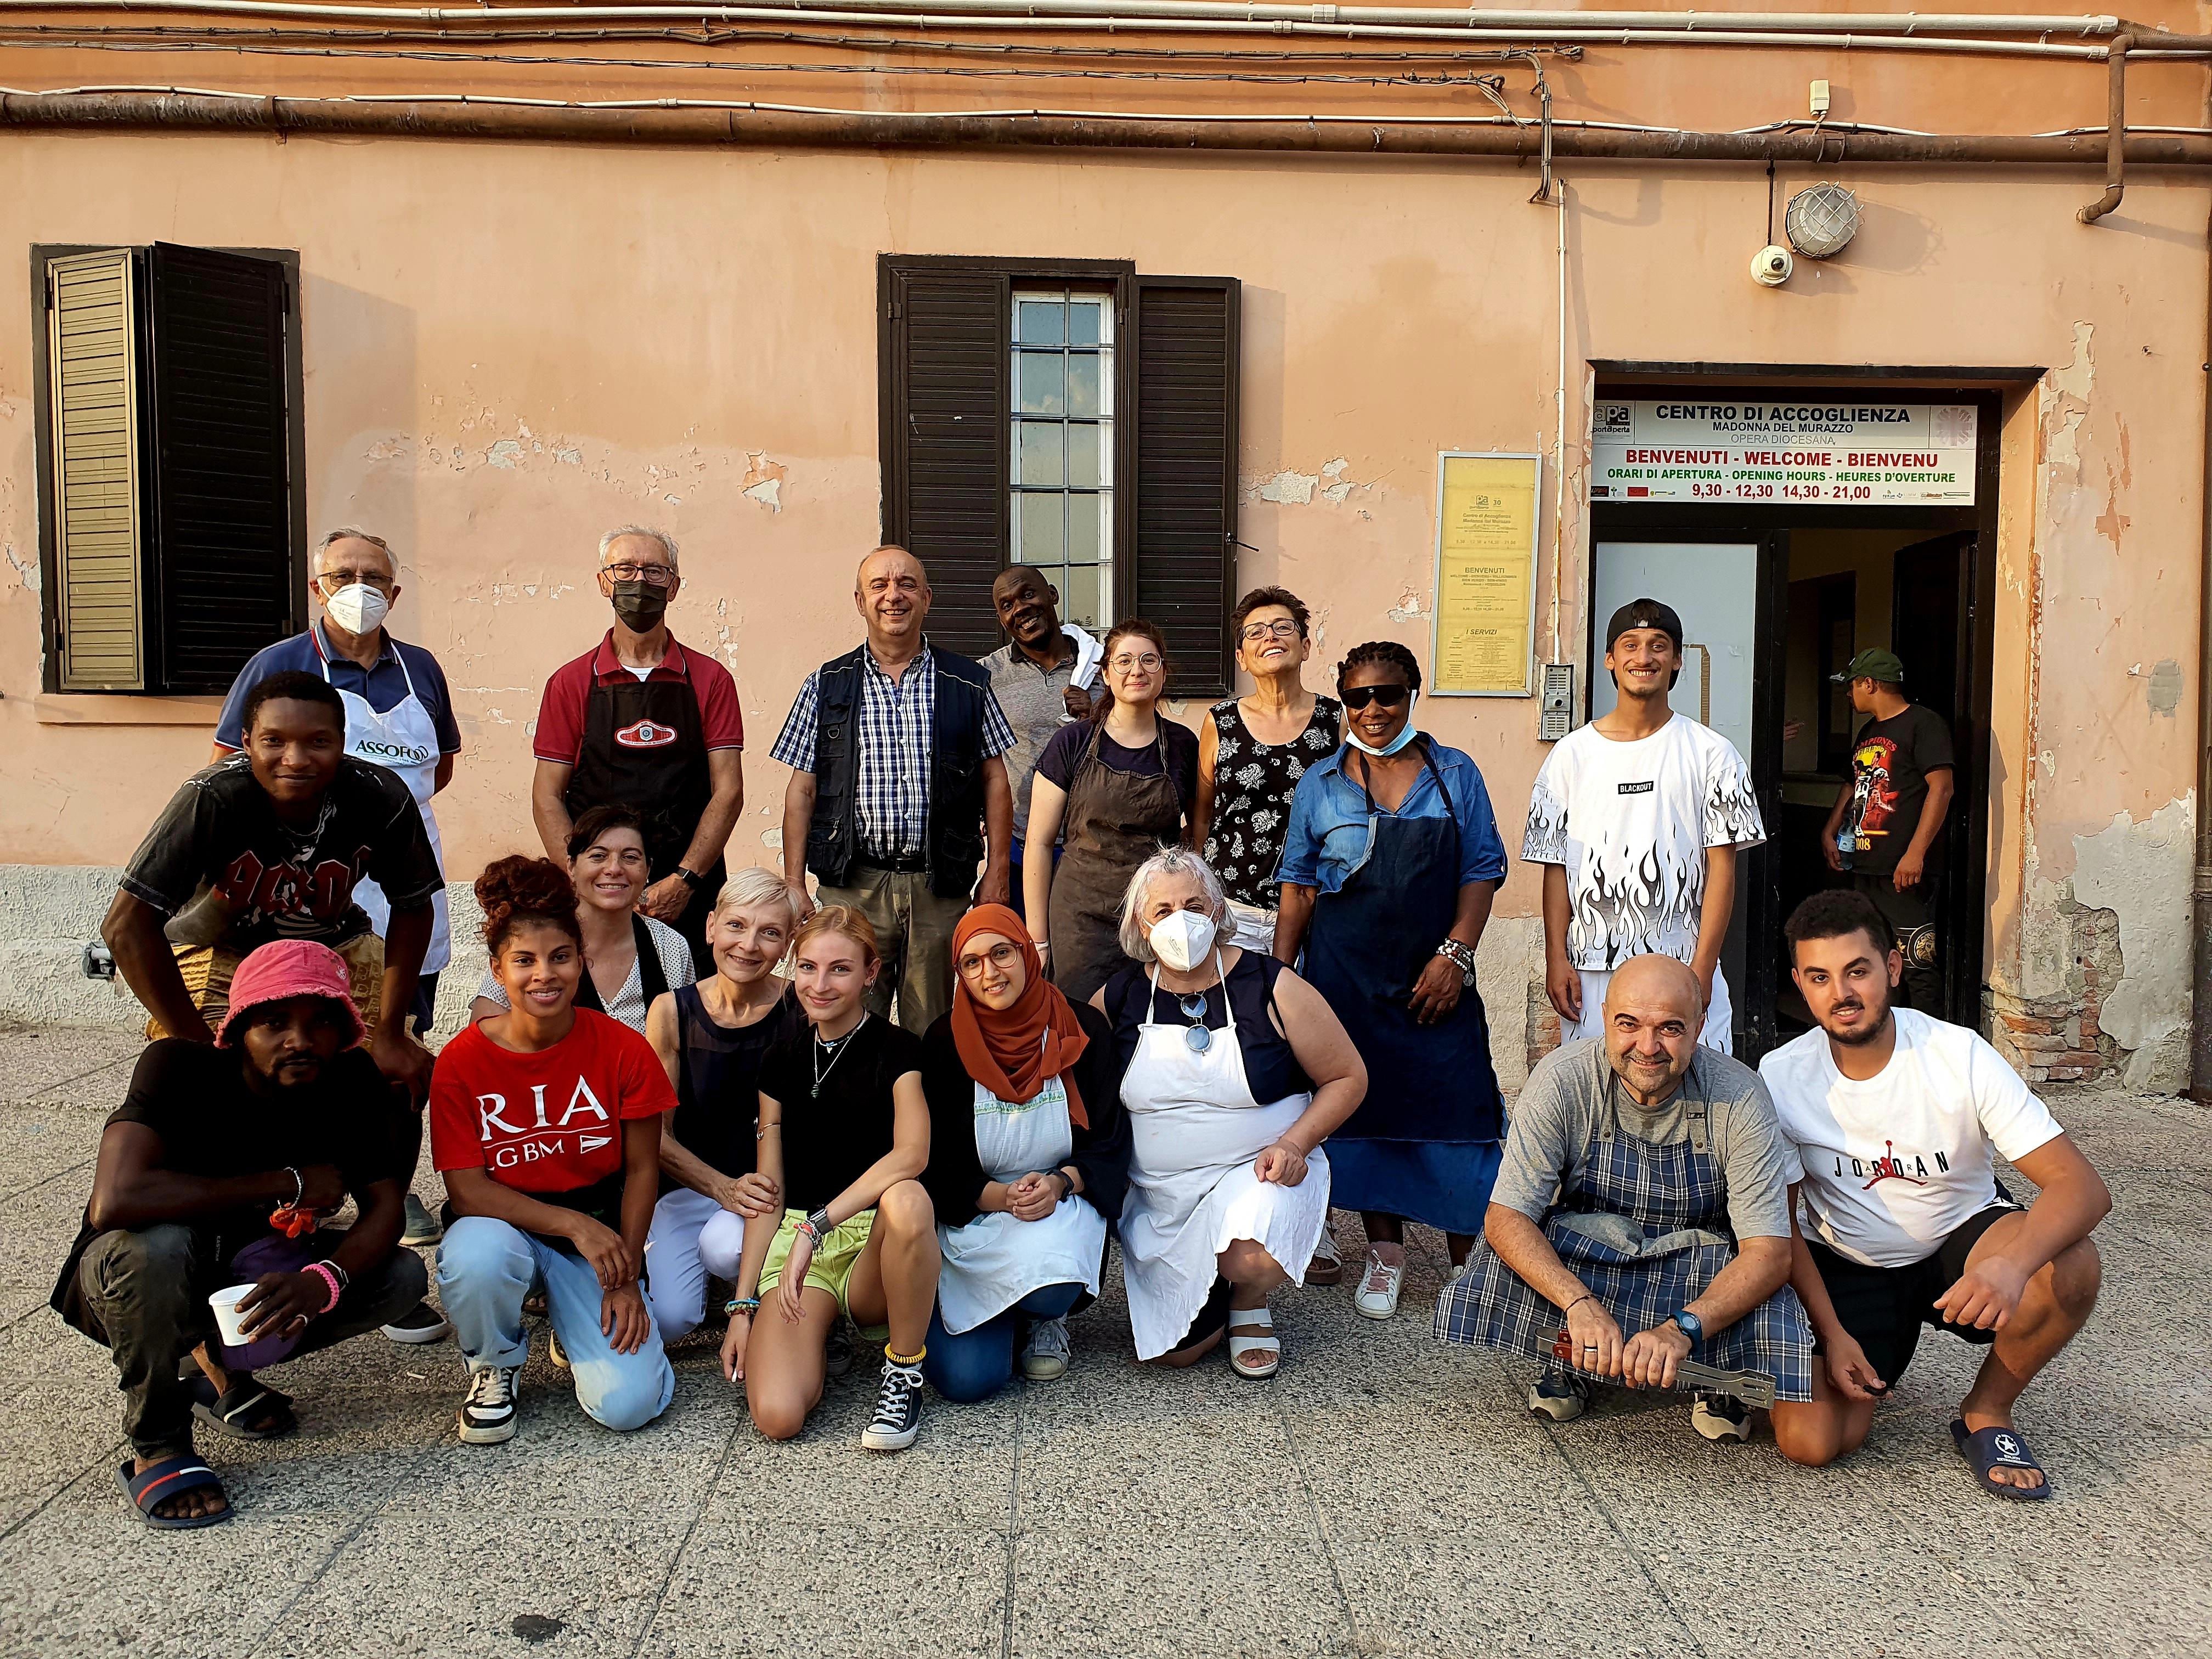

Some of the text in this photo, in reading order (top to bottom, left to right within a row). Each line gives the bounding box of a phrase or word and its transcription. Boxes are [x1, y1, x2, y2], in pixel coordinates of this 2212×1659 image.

[1656, 405, 1911, 422] CENTRO DI ACCOGLIENZA
[1712, 422, 1853, 433] MADONNA DEL MURAZZO
[1731, 434, 1835, 445] OPERA DIOCESANA
[1626, 449, 1728, 464] BENVENUTI
[1744, 451, 1831, 466] WELCOME
[1848, 453, 1938, 467] BIENVENU
[1607, 468, 1643, 479] ORARI
[1646, 469, 1657, 479] DI
[1661, 469, 1722, 479] APERTURA
[1732, 470, 1783, 481] OPENING
[1787, 471, 1826, 481] HOURS
[1836, 472, 1881, 482] HEURES
[1884, 472, 1956, 483] D'OVERTURE
[1692, 483, 1722, 498] 9,30
[1735, 484, 1773, 499] 12,30
[1782, 485, 1820, 500] 14,30
[1832, 486, 1871, 501] 21,00
[1620, 782, 1652, 793] BLACKOUT
